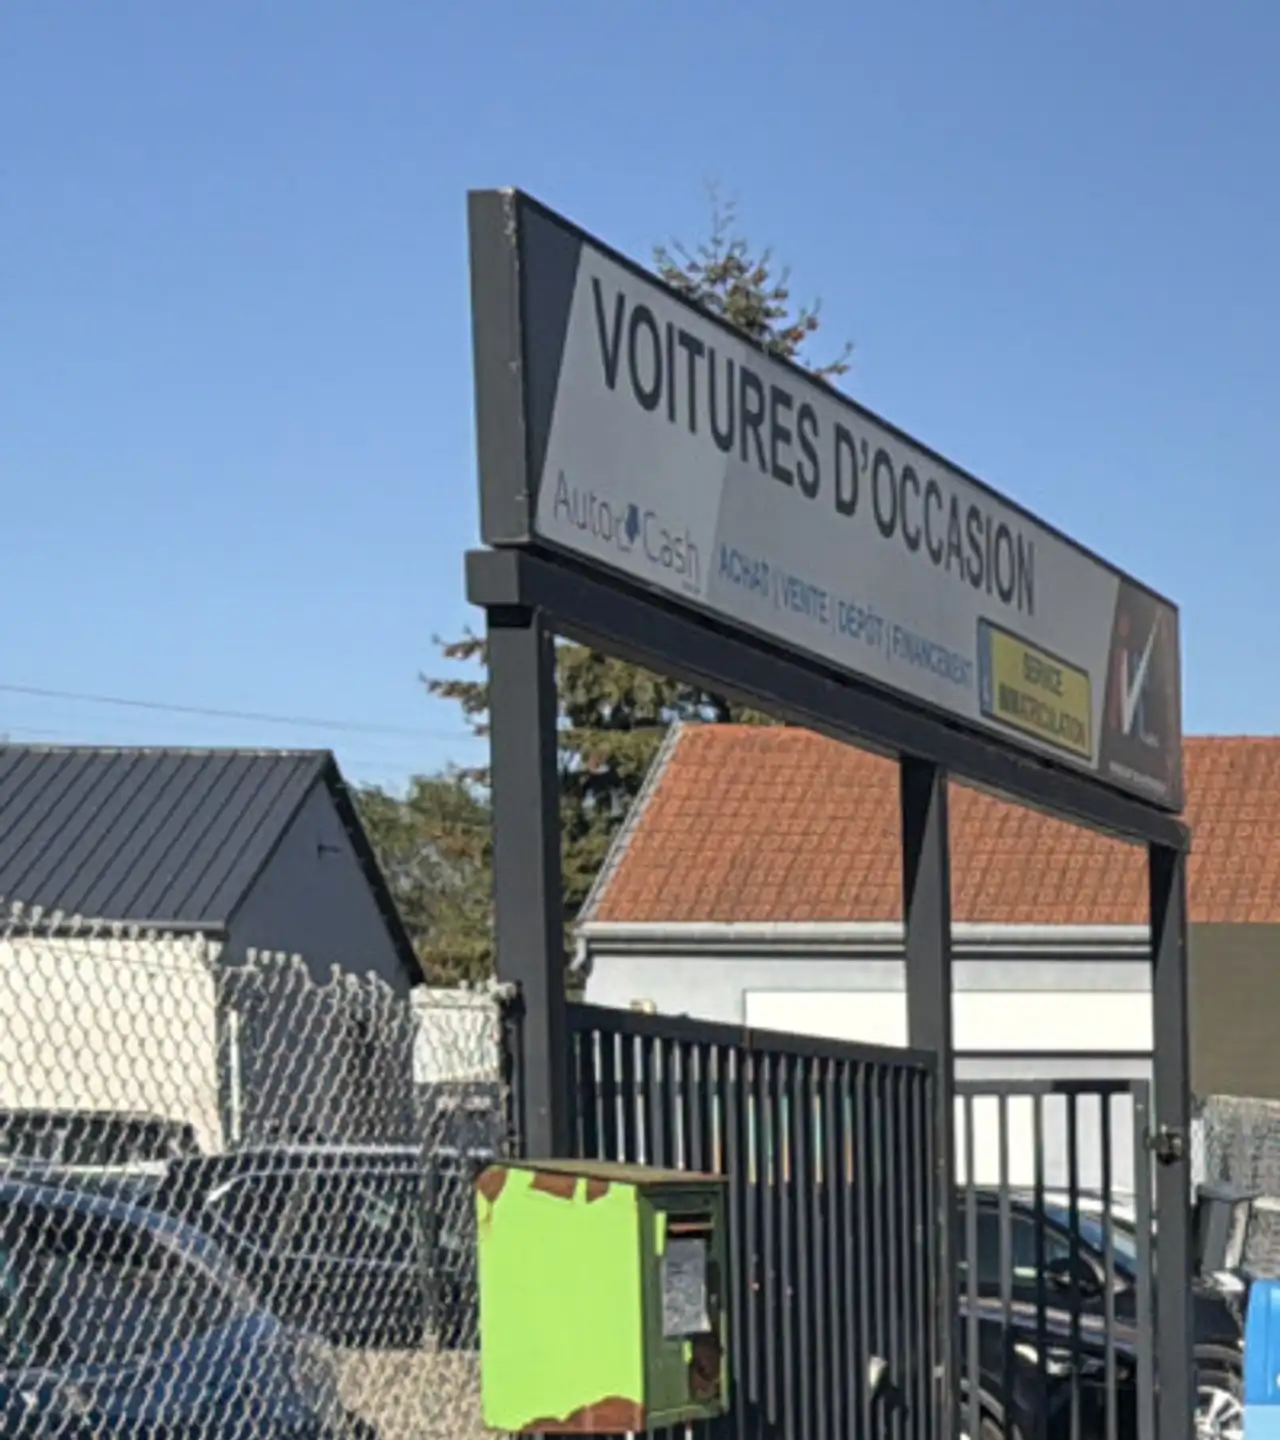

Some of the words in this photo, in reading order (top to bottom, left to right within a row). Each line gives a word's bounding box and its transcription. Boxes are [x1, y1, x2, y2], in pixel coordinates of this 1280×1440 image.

[592, 276, 819, 500] VOITURES
[835, 422, 1034, 615] D'OCCASION
[554, 469, 612, 542] Auto
[643, 510, 699, 582] Cash
[718, 543, 769, 597] ACHAT
[780, 571, 828, 624] VENTE
